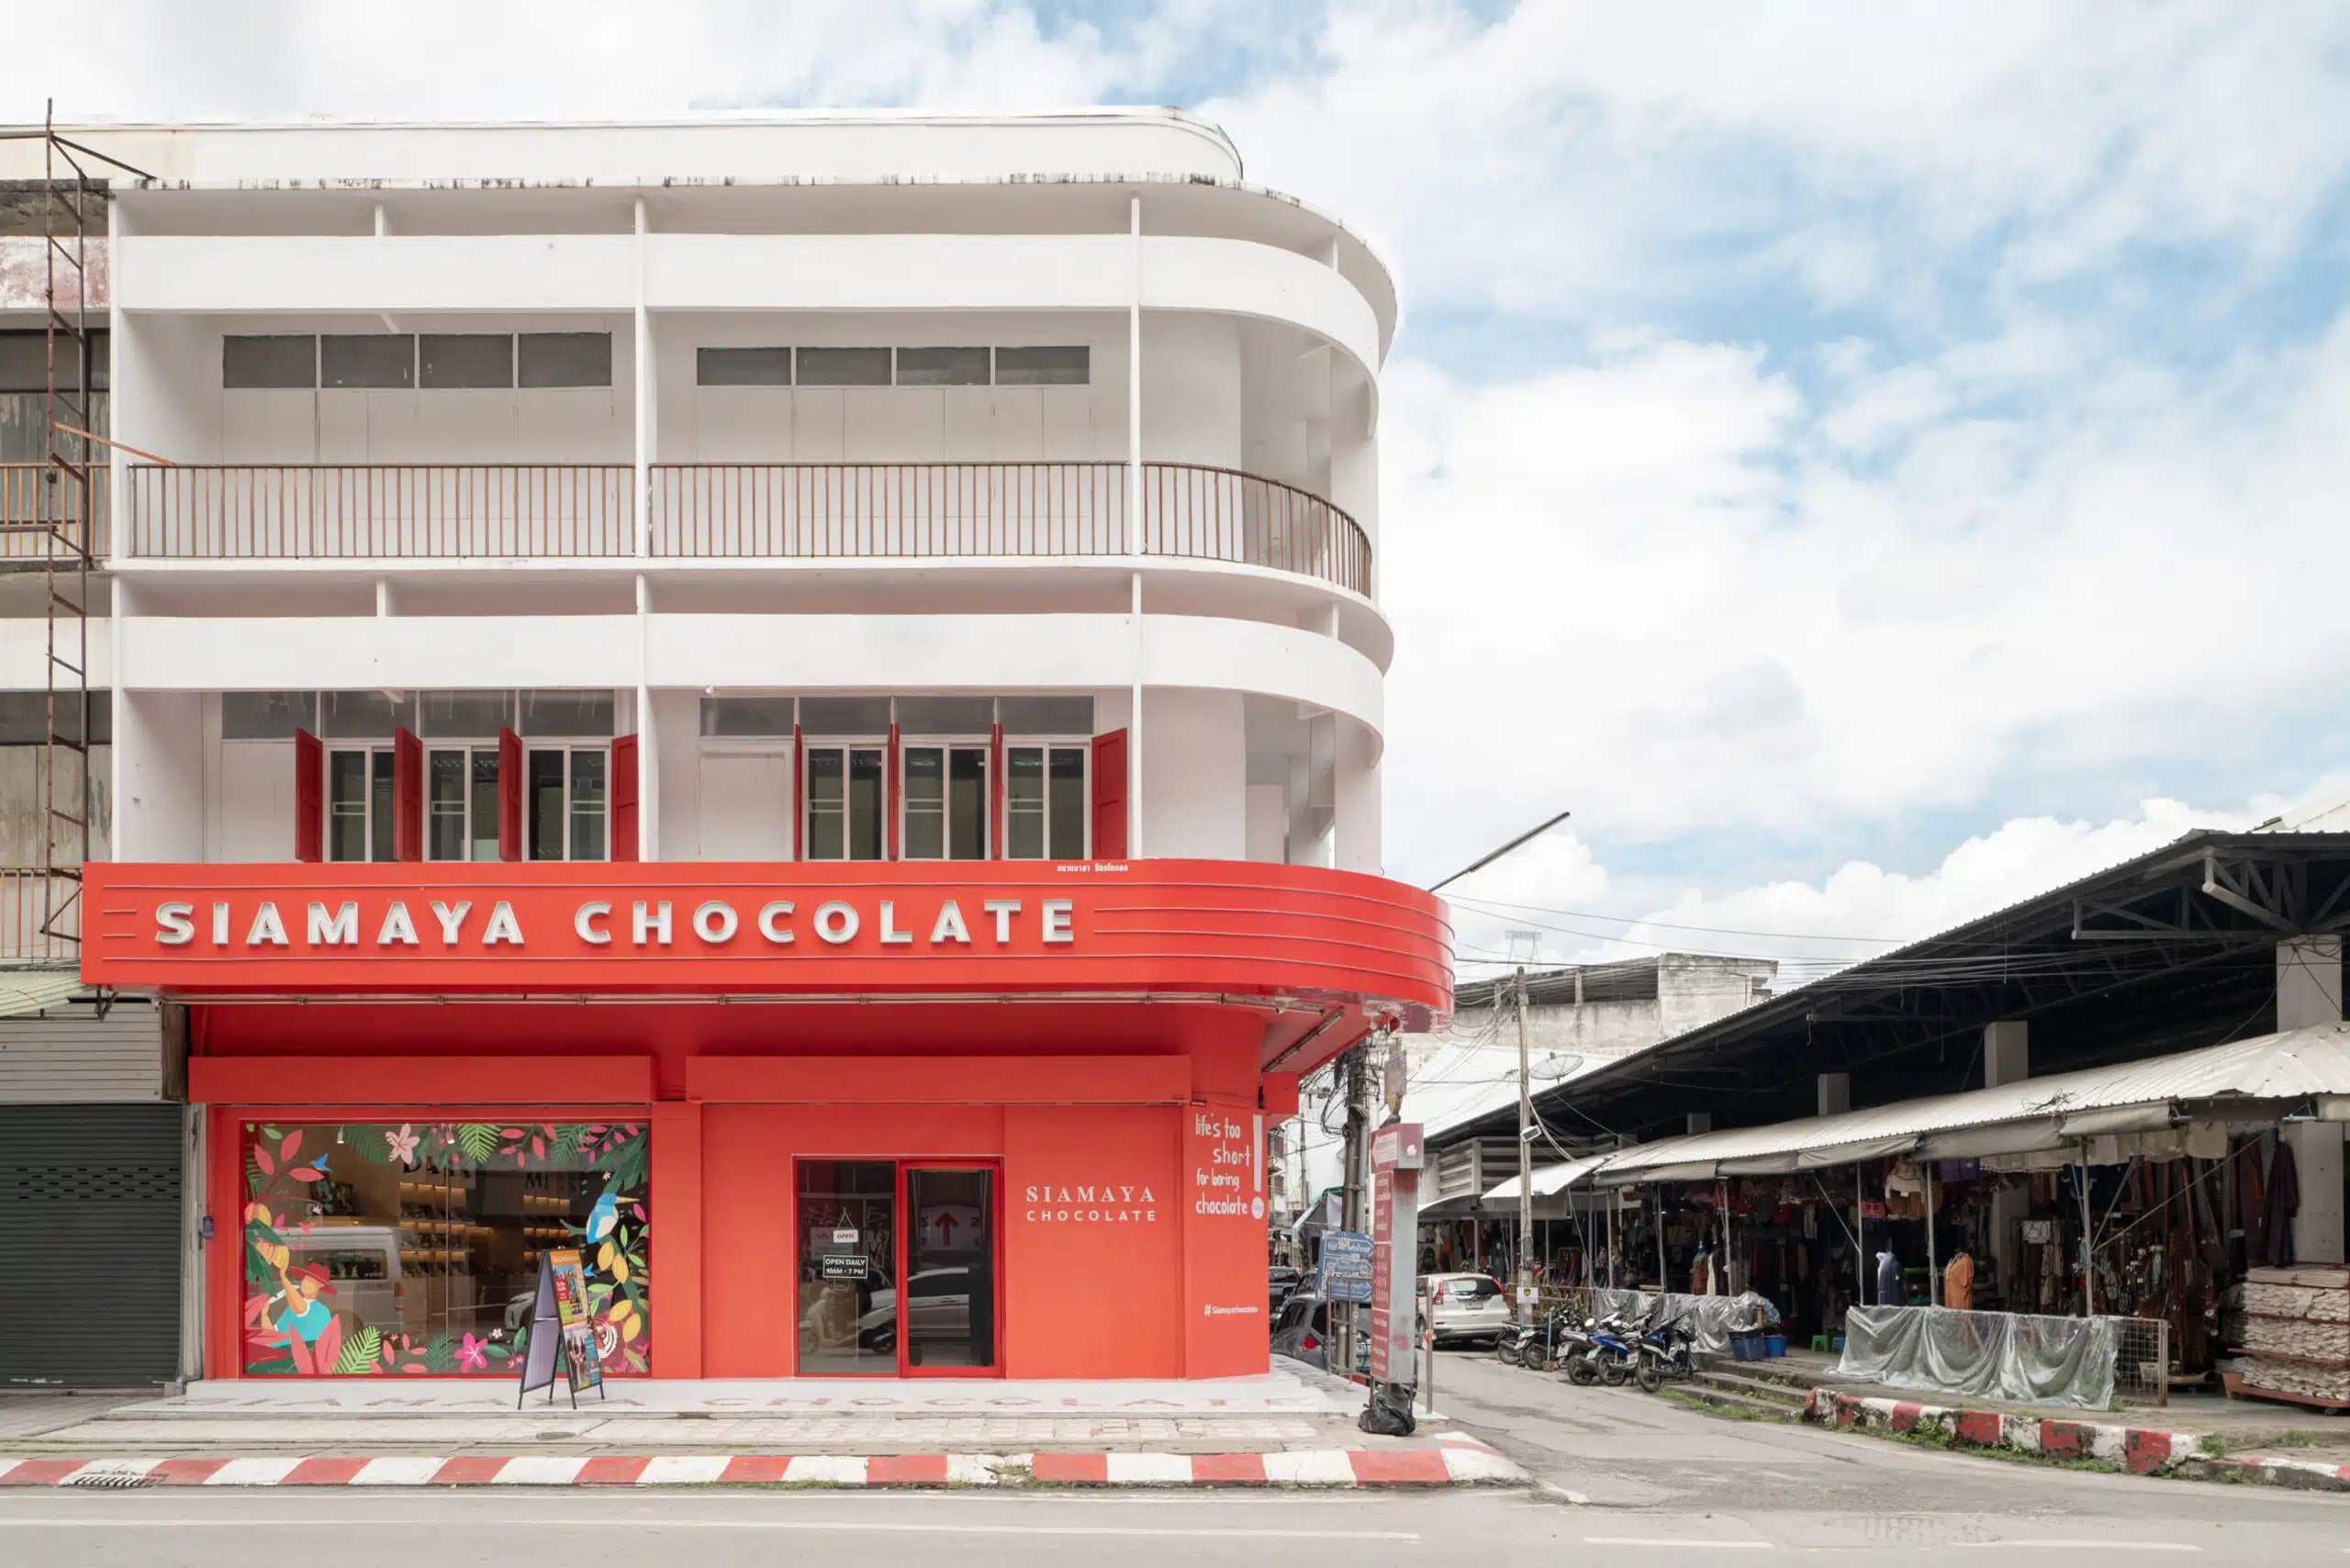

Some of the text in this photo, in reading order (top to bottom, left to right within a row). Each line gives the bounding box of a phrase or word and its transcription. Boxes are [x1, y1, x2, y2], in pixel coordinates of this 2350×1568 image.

[155, 899, 1075, 946] SIAMAYA CHOCOLATE
[1224, 1116, 1241, 1139] too
[1213, 1139, 1251, 1168] short
[1196, 1167, 1240, 1192] for boring
[1025, 1185, 1156, 1203] SIAMAYA
[1195, 1192, 1248, 1215] chocolate
[1025, 1209, 1157, 1222] CHOCOLATE
